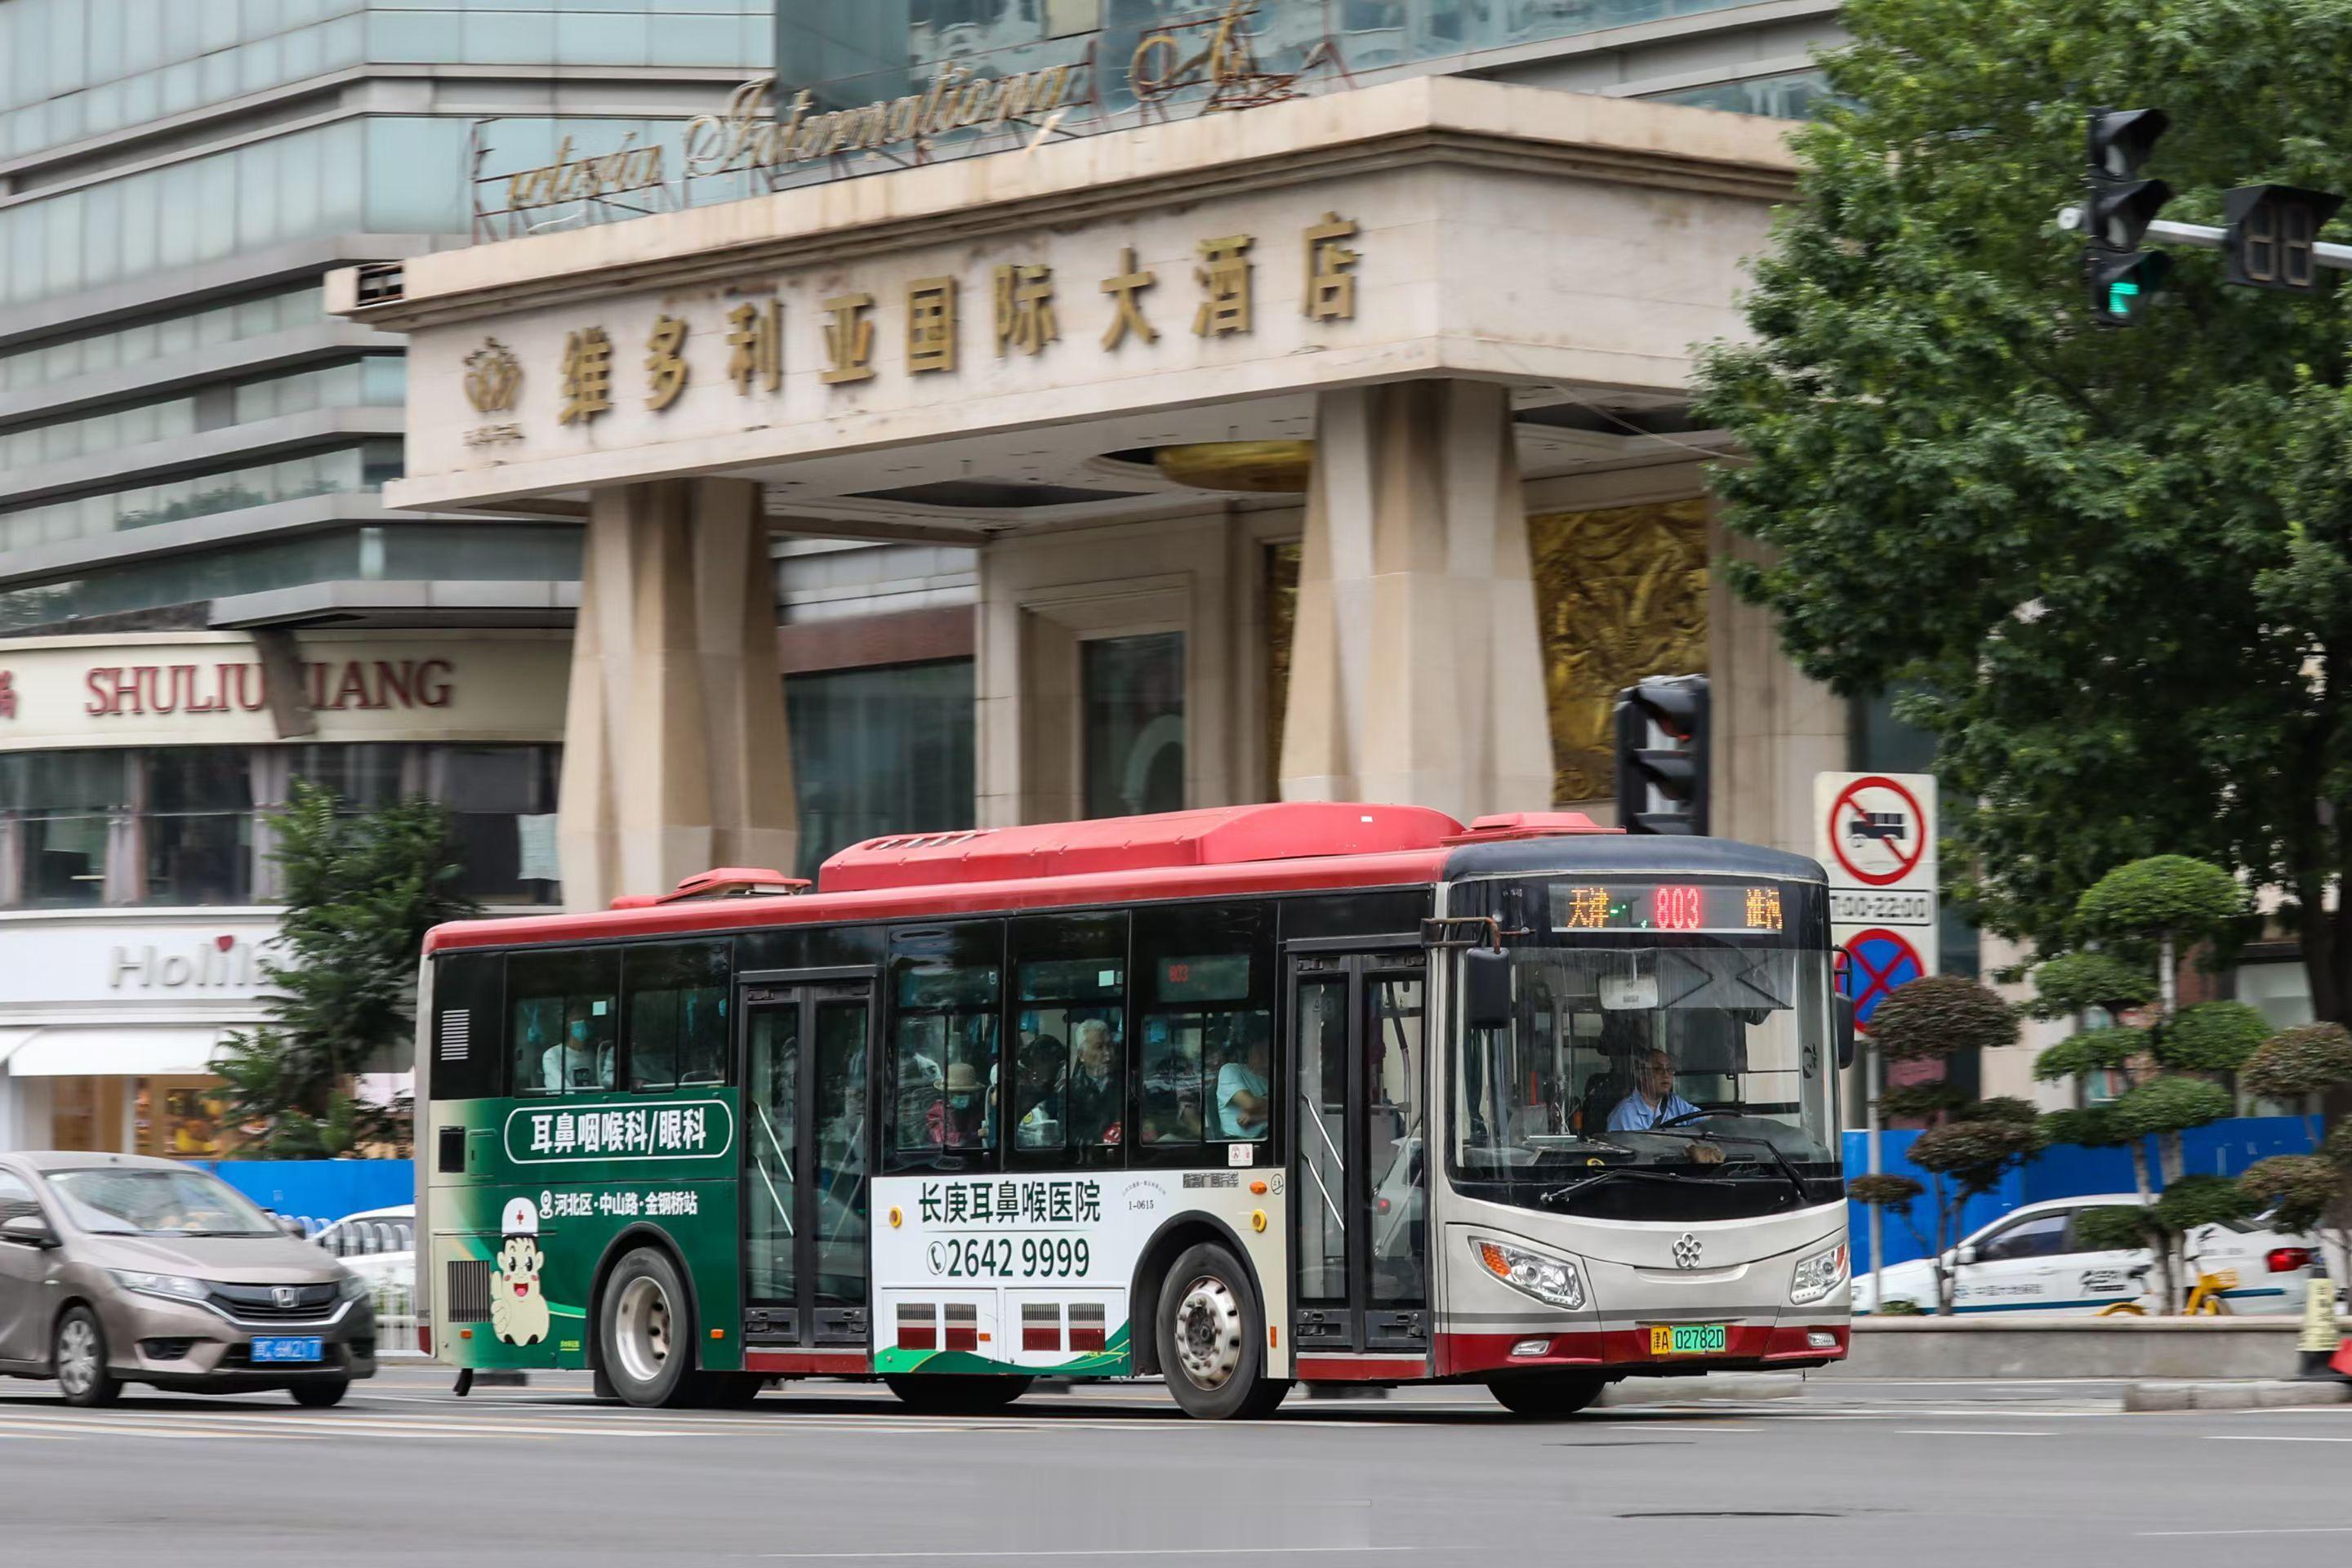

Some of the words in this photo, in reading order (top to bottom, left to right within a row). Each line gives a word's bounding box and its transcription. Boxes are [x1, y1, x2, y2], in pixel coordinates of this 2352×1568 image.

[559, 211, 1359, 427] 维多利亚国际大酒店
[84, 660, 456, 715] SHULIUIANG
[1567, 887, 1610, 929] 天津
[1655, 886, 1700, 929] 803
[530, 1107, 707, 1156] 耳鼻咽喉科/眼科
[918, 1179, 1102, 1224] 长庚耳鼻喉医院
[947, 1238, 1013, 1278] 2642
[1022, 1237, 1090, 1278] 9999
[1675, 1328, 1725, 1350] 02782D
